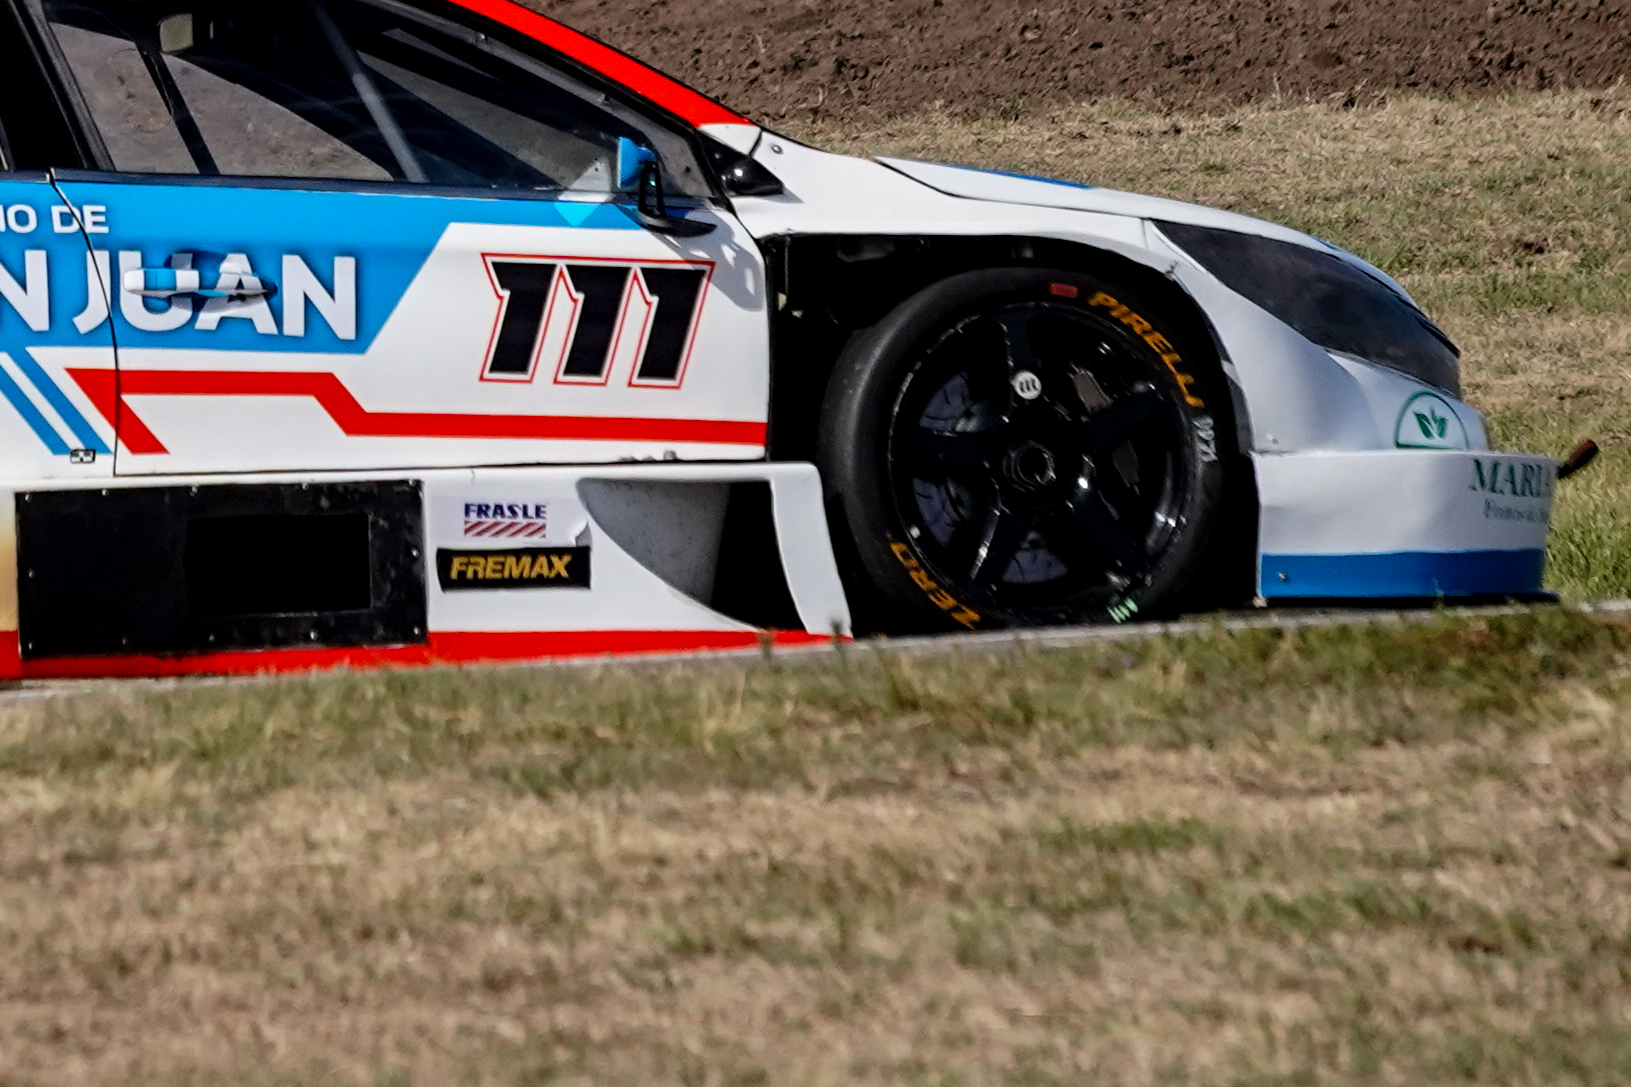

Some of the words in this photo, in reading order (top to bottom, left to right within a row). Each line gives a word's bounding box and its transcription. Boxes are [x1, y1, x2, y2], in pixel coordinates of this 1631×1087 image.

[52, 204, 110, 235] DE
[72, 249, 357, 342] JUAN
[478, 253, 717, 390] 111
[1087, 291, 1206, 408] PIRELLI
[463, 502, 548, 520] FRASLE
[449, 553, 573, 581] FREMAX
